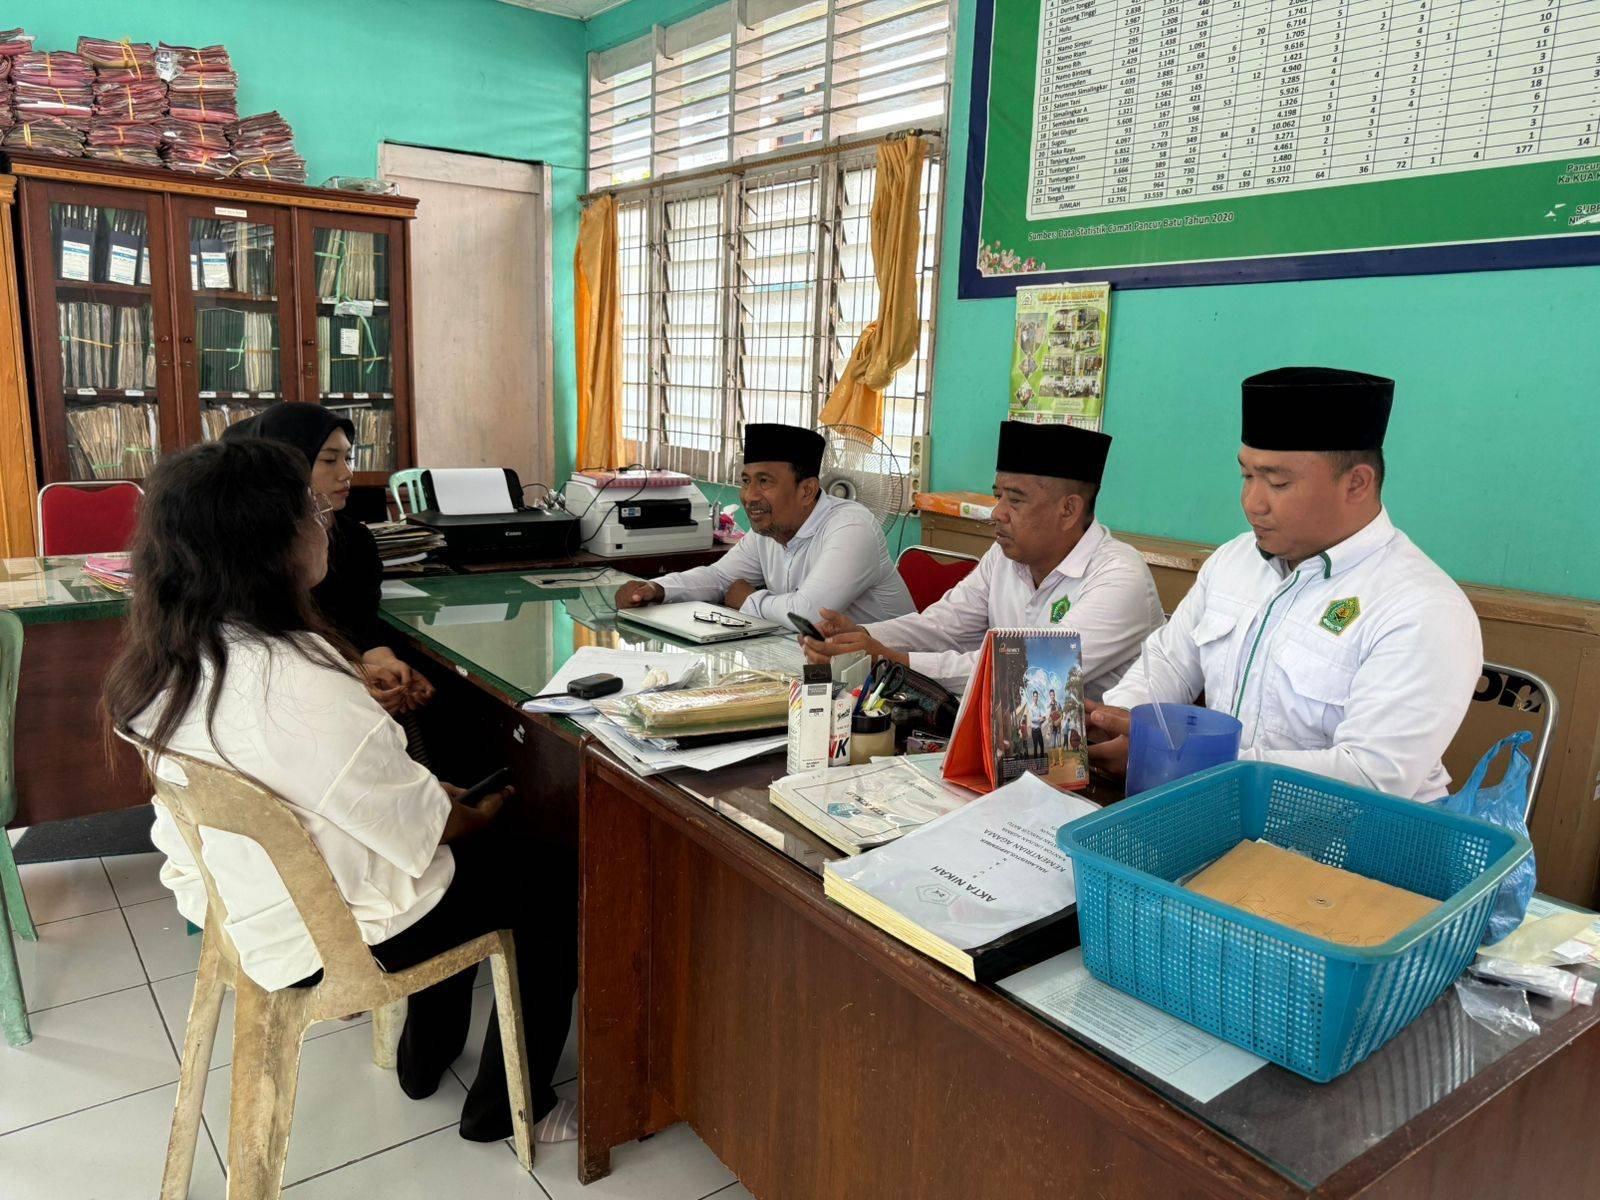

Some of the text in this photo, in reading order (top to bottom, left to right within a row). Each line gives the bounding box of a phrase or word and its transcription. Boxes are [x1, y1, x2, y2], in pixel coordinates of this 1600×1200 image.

[1125, 6, 1140, 15] 2.838
[1125, 17, 1140, 25] 2.987
[1162, 7, 1178, 15] 2.051
[1160, 38, 1176, 47] 1.438
[1288, 7, 1307, 16] 1.741
[1162, 17, 1178, 26] 1.208
[1072, 68, 1091, 76] Bintang
[1159, 49, 1175, 57] 3.174
[1287, 19, 1306, 28] 6.714
[1158, 59, 1174, 68] 1.148
[1286, 30, 1305, 39] 1.705
[1157, 70, 1173, 78] 2.885
[1284, 42, 1304, 51] 9.616
[1284, 53, 1302, 62] 1.421
[1282, 65, 1301, 73] 4.940
[1281, 76, 1300, 84] 3.285
[1280, 87, 1299, 96] 5.926
[1273, 120, 1295, 129] 10.062
[1275, 132, 1293, 140] 3.271
[1267, 176, 1289, 185] 95.972
[1578, 138, 1589, 146] 14
[1573, 172, 1594, 182] KUA
[1058, 230, 1075, 238] Data
[1076, 227, 1106, 236] Statistik
[1108, 225, 1133, 233] Camat
[1134, 221, 1162, 231] Pancur
[1164, 218, 1182, 228] Batu
[1184, 216, 1210, 225] Tahun
[1212, 213, 1234, 223] 2020
[983, 828, 1012, 845] AGAMA
[1012, 843, 1066, 872] KEMENTRIAN
[930, 865, 966, 886] NIKAH
[964, 884, 997, 902] AKTA
